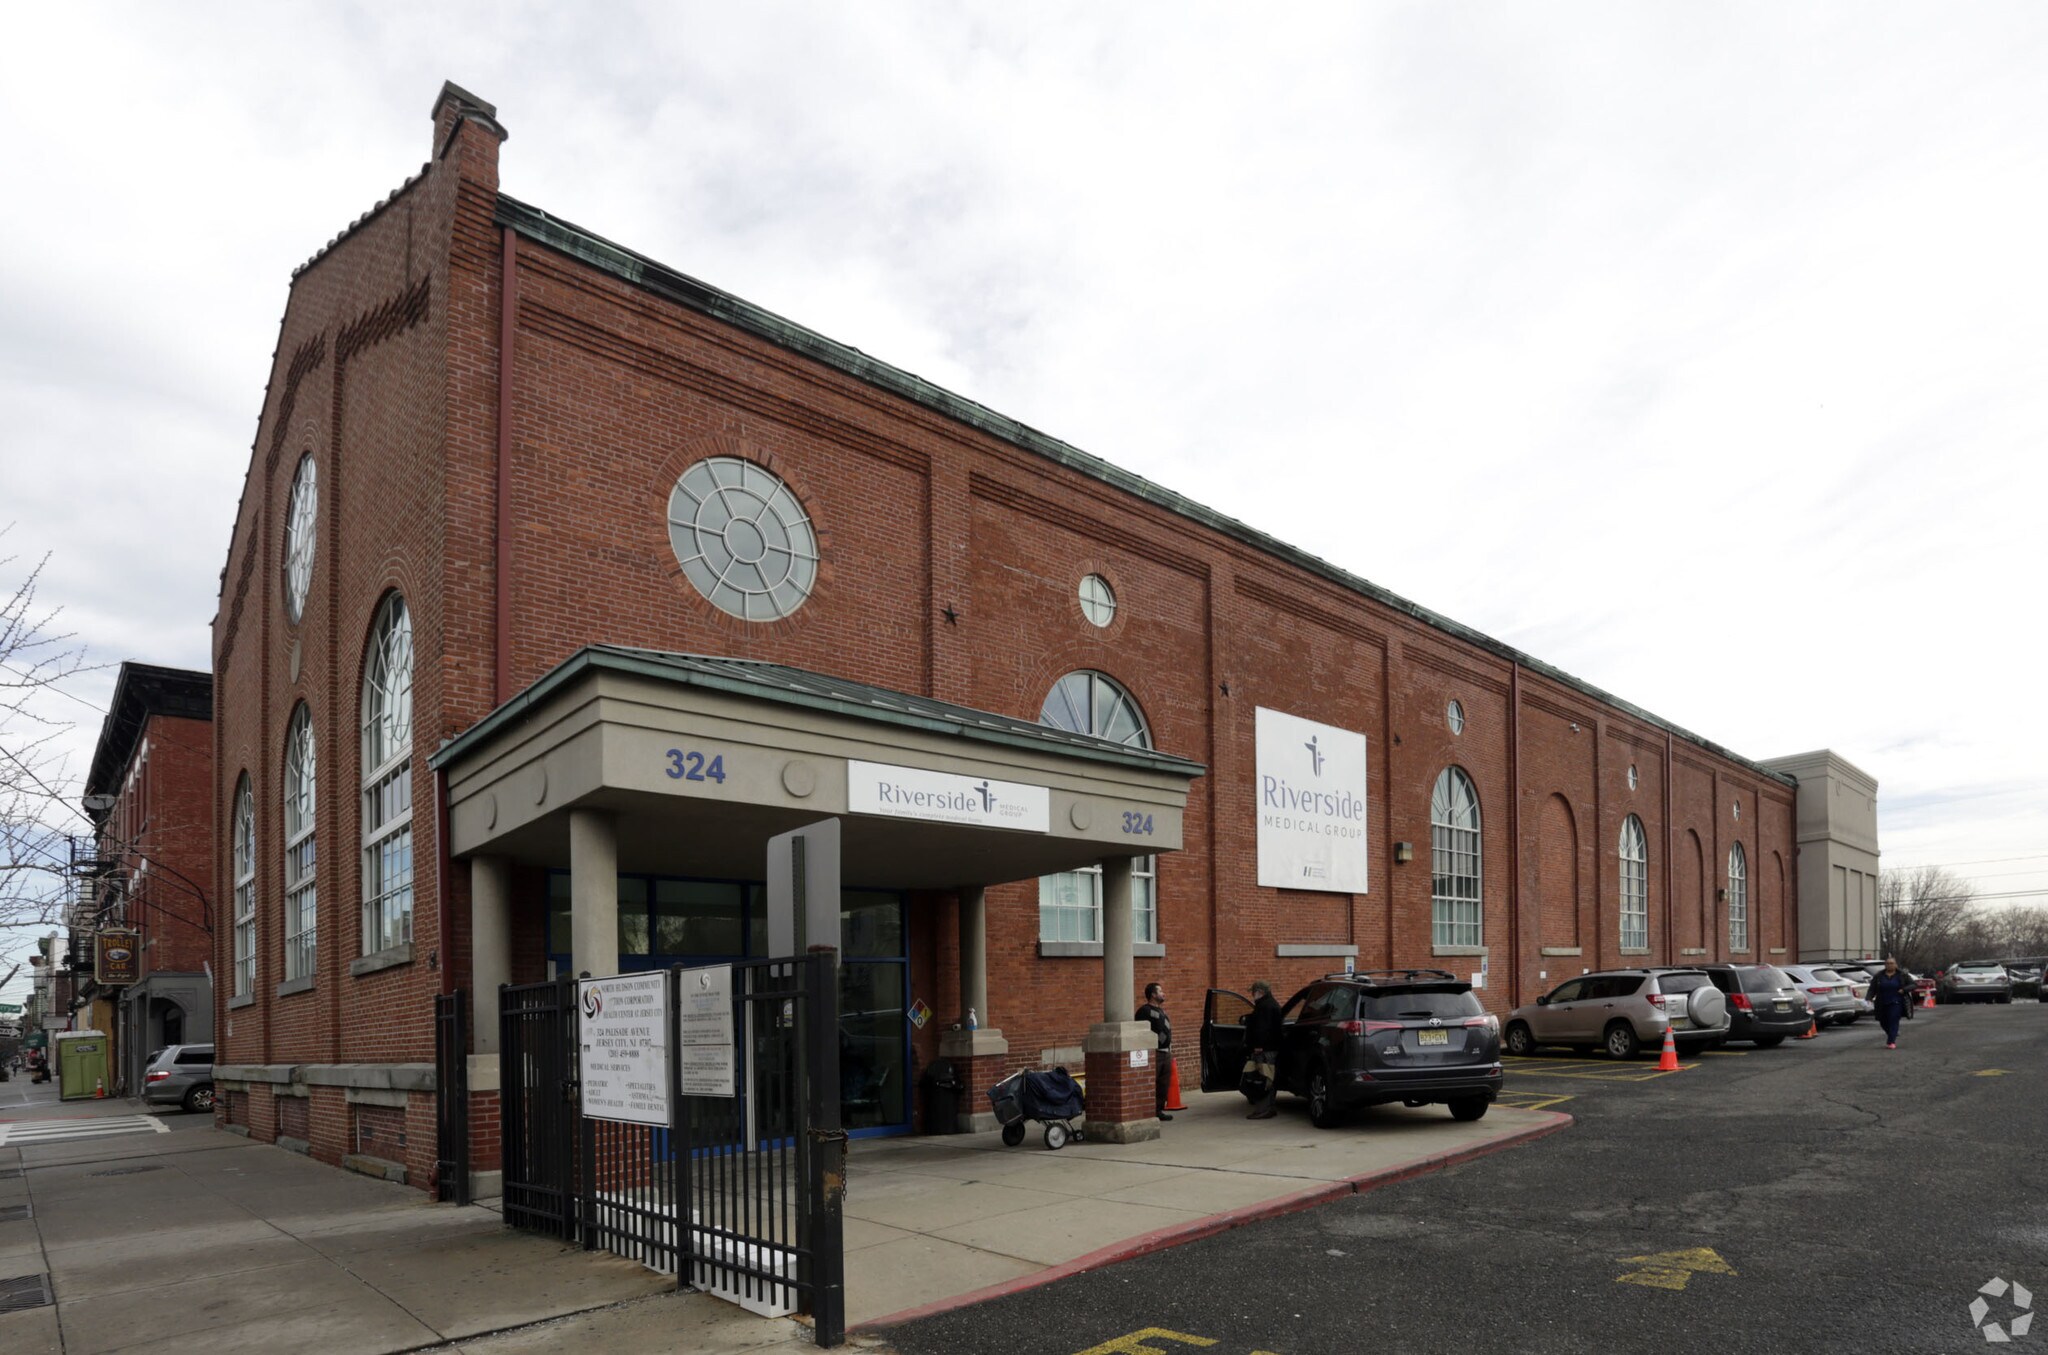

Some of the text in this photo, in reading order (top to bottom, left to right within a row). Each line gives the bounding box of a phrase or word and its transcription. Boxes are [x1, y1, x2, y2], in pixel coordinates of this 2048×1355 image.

[666, 749, 726, 784] 324
[877, 781, 977, 812] Riverside
[1263, 775, 1363, 821] Riverside
[1000, 803, 1029, 812] MEDICAL
[1000, 810, 1023, 818] GROUP
[1122, 811, 1154, 836] 324
[1264, 815, 1363, 839] MEDICAL GROUP
[102, 938, 133, 949] TROLLEY
[634, 980, 660, 990] COMMUNITY
[605, 1027, 629, 1037] PALISADE
[630, 1026, 650, 1037] AVENUE
[596, 1038, 613, 1047] JERSEY
[590, 1063, 631, 1072] MEDICAL SERVICES
[647, 1103, 665, 1112] DENTAL
